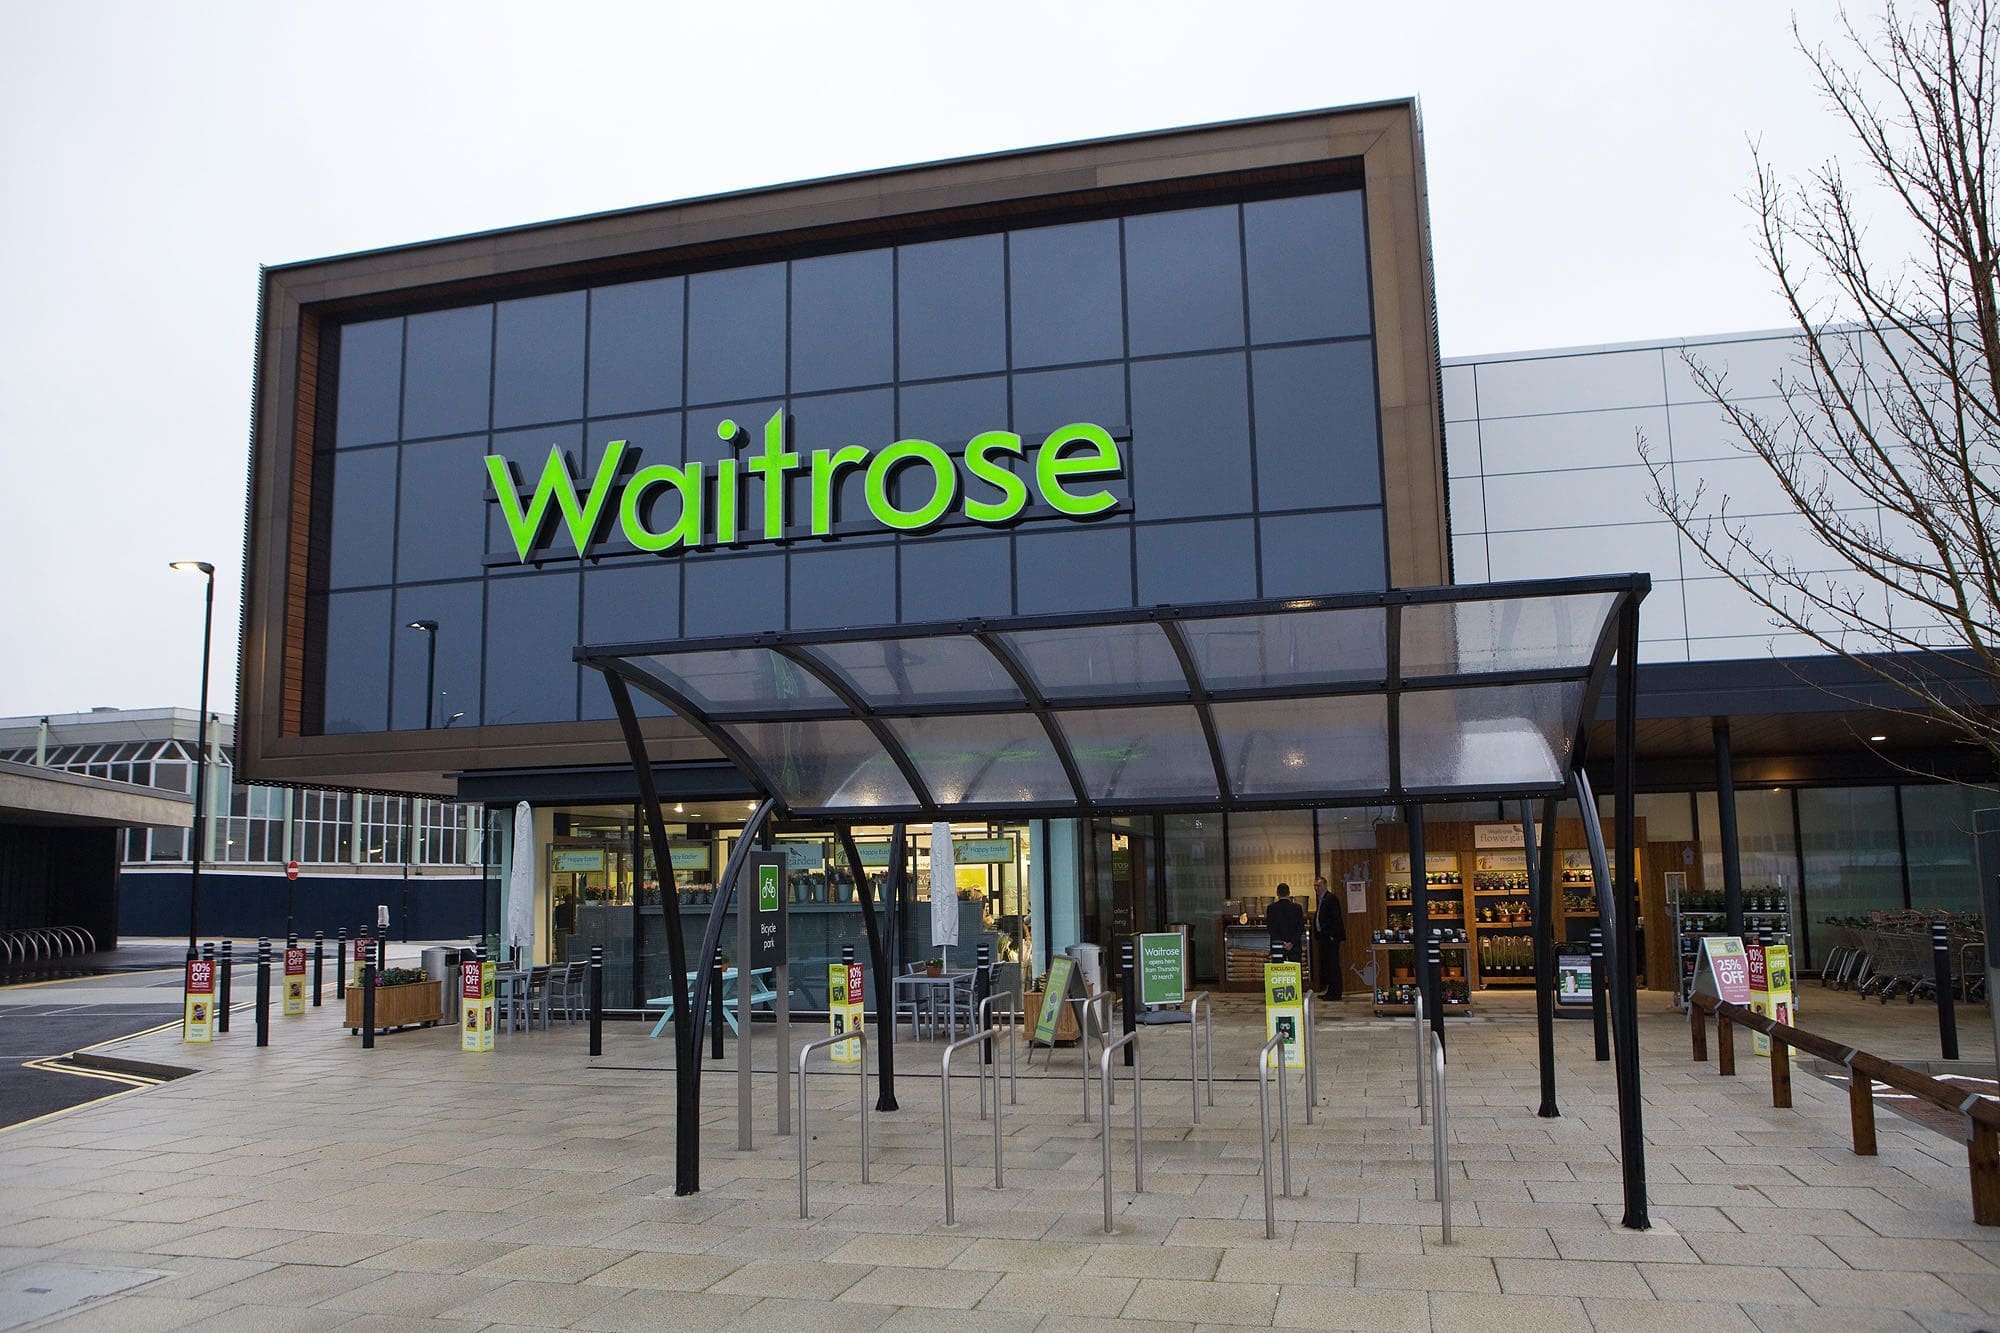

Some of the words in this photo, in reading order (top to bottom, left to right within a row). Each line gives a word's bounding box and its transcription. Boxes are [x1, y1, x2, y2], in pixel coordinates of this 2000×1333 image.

[484, 407, 1123, 565] Waitrose
[1480, 833, 1508, 843] flower
[760, 922, 777, 937] Bicycle
[763, 937, 775, 951] park
[288, 950, 304, 958] 10%
[1144, 946, 1180, 957] Waitrose
[1749, 948, 1764, 962] 10%
[288, 958, 303, 966] OFF
[1148, 959, 1163, 967] opens
[1717, 958, 1742, 971] 25%
[1750, 961, 1764, 974] OFF
[1770, 960, 1786, 968] OFFER
[191, 963, 211, 973] 10%
[465, 964, 479, 975] 10%
[849, 967, 862, 979] 10%
[191, 972, 210, 982] OFF
[465, 975, 479, 985] OFF
[1271, 976, 1297, 984] OFFER
[1721, 970, 1745, 985] OFF
[849, 977, 862, 989] OFF
